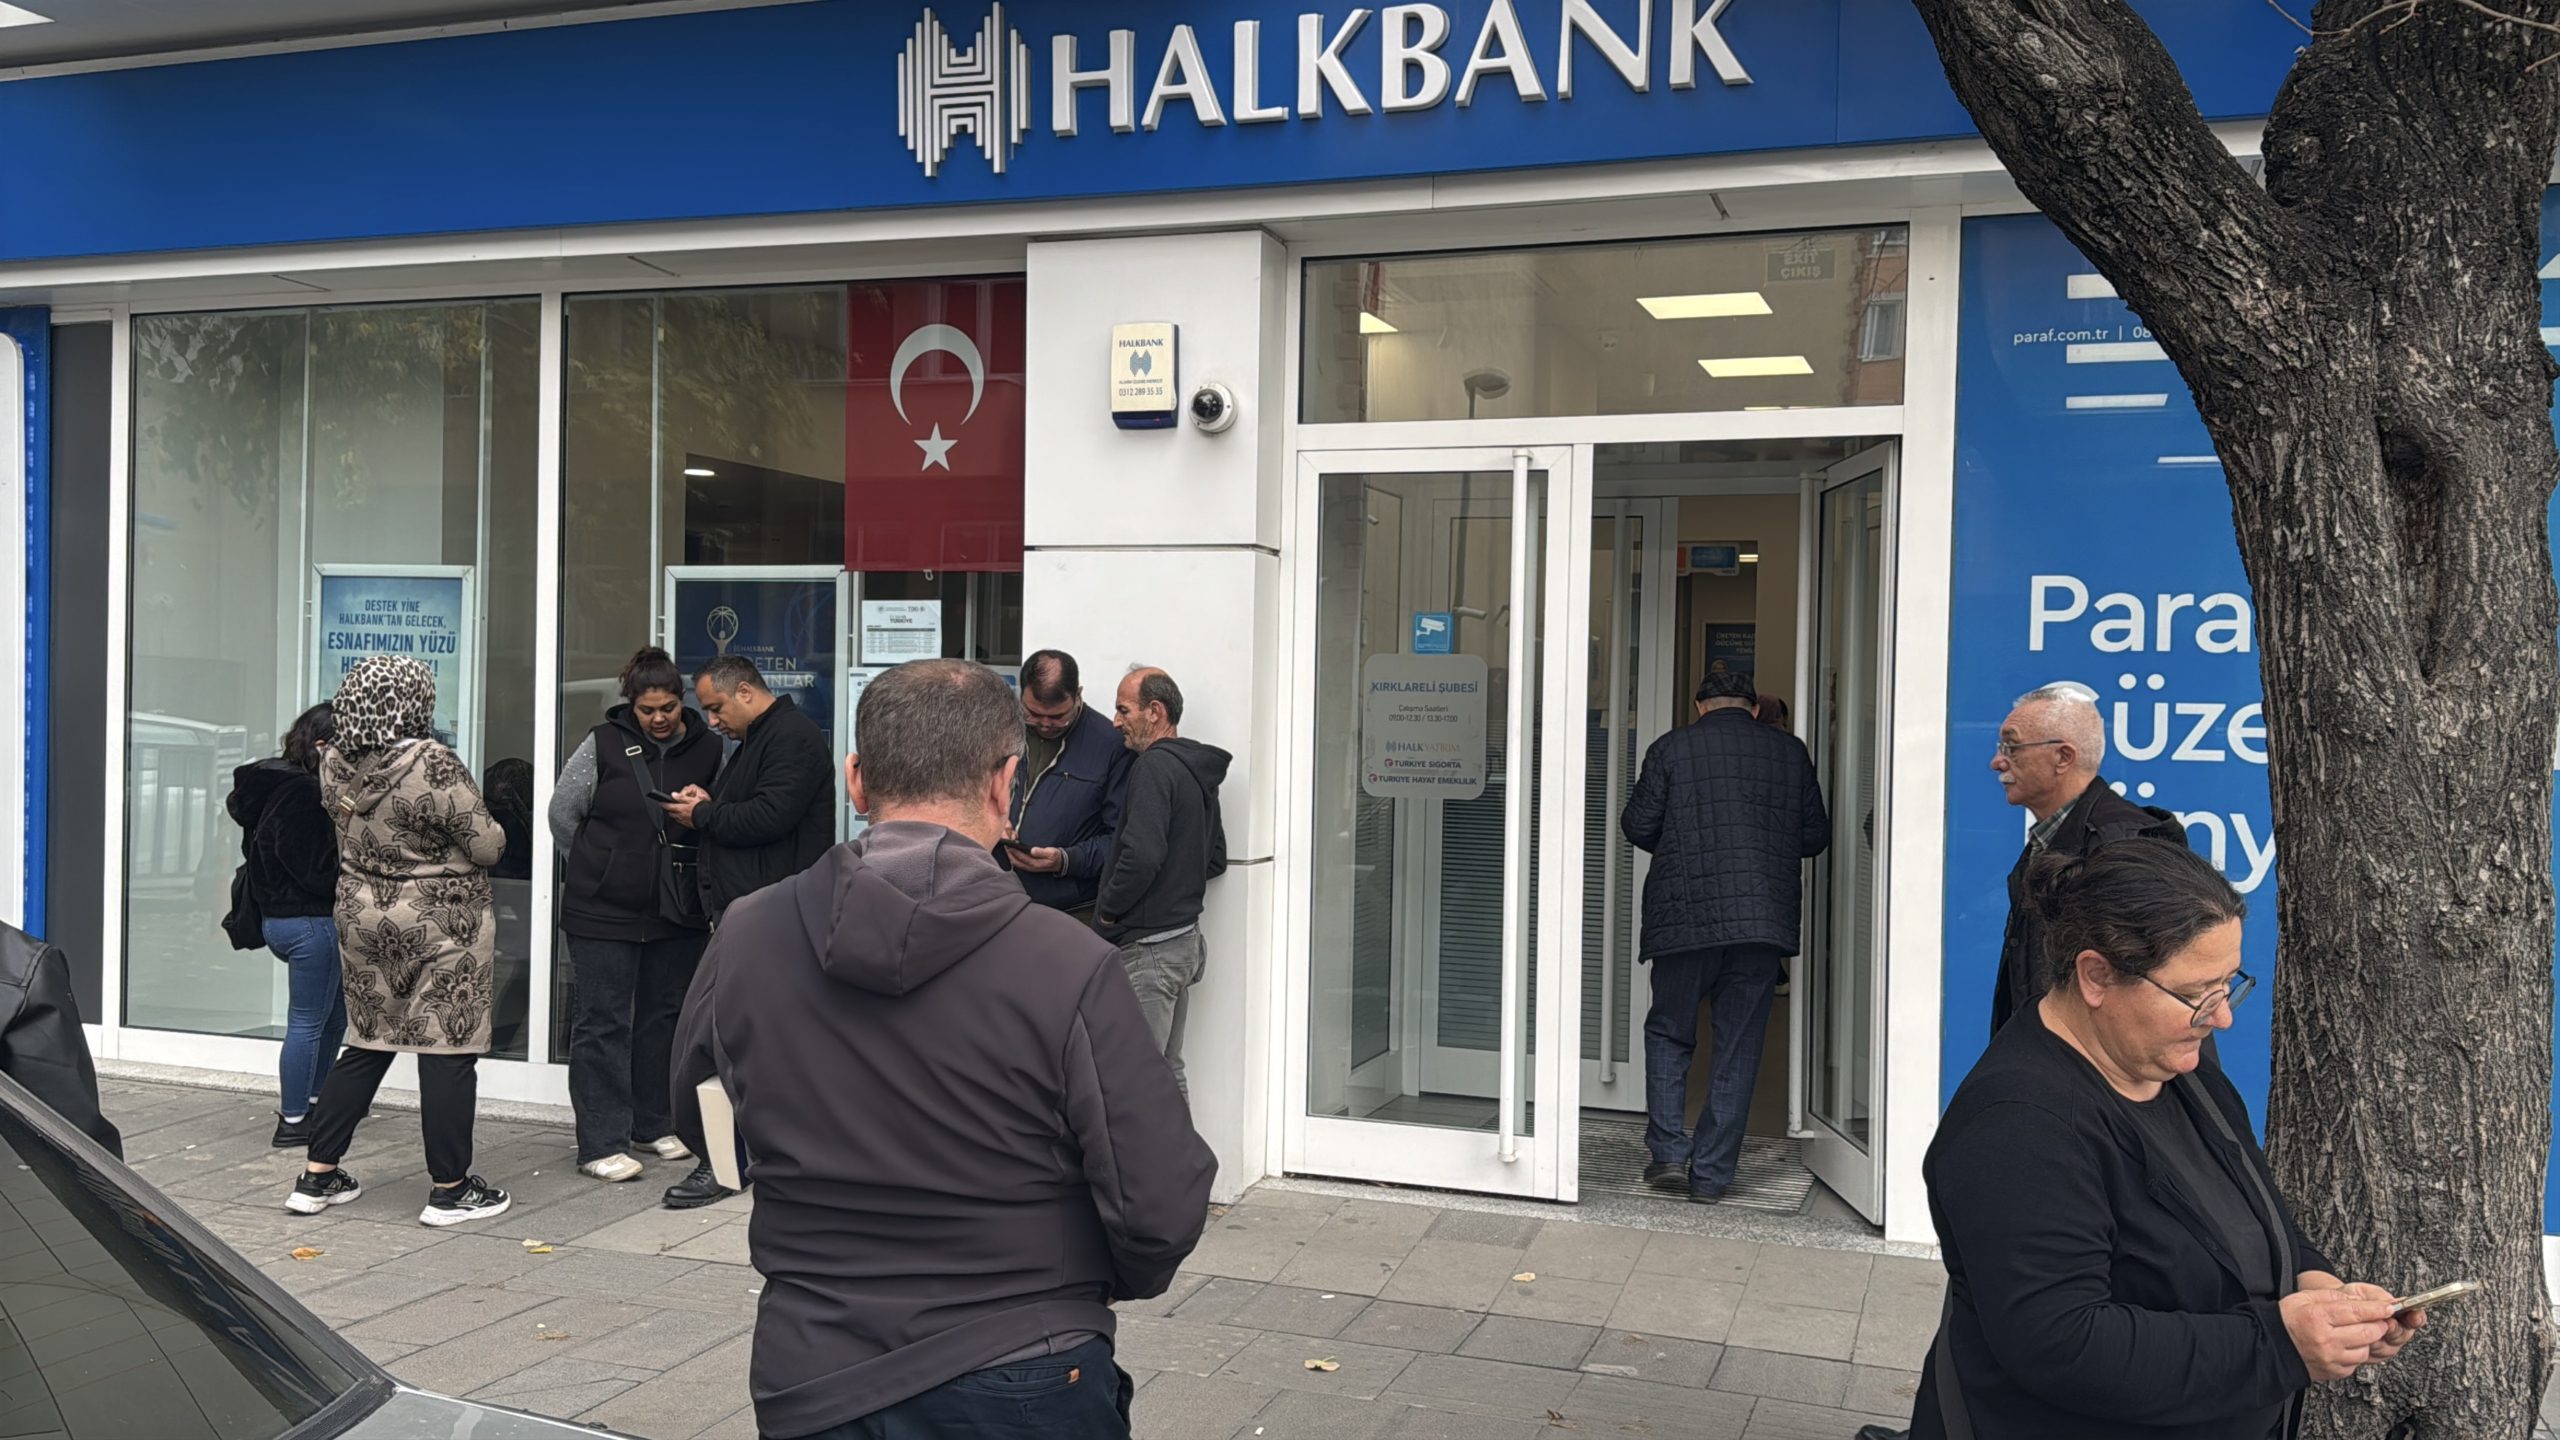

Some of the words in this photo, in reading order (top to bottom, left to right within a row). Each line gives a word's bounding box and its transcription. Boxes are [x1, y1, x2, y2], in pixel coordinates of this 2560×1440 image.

[1052, 0, 1754, 137] HALKBANK
[1118, 338, 1164, 348] HALKBANK
[2013, 328, 2109, 346] paraf.com.tr
[1118, 387, 1134, 397] 0312
[364, 599, 398, 612] DESTEK
[401, 597, 421, 612] YİNE
[338, 612, 403, 626] HALKBANK'TAN
[405, 614, 447, 629] GELECEK,
[2029, 575, 2251, 654] Para
[327, 631, 414, 653] ESNAFIMIZIN
[419, 631, 457, 654] YÜZÜ
[1438, 681, 1478, 694] ŞUBESİ
[2041, 673, 2269, 764] üze
[1411, 776, 1436, 784] HAYAT
